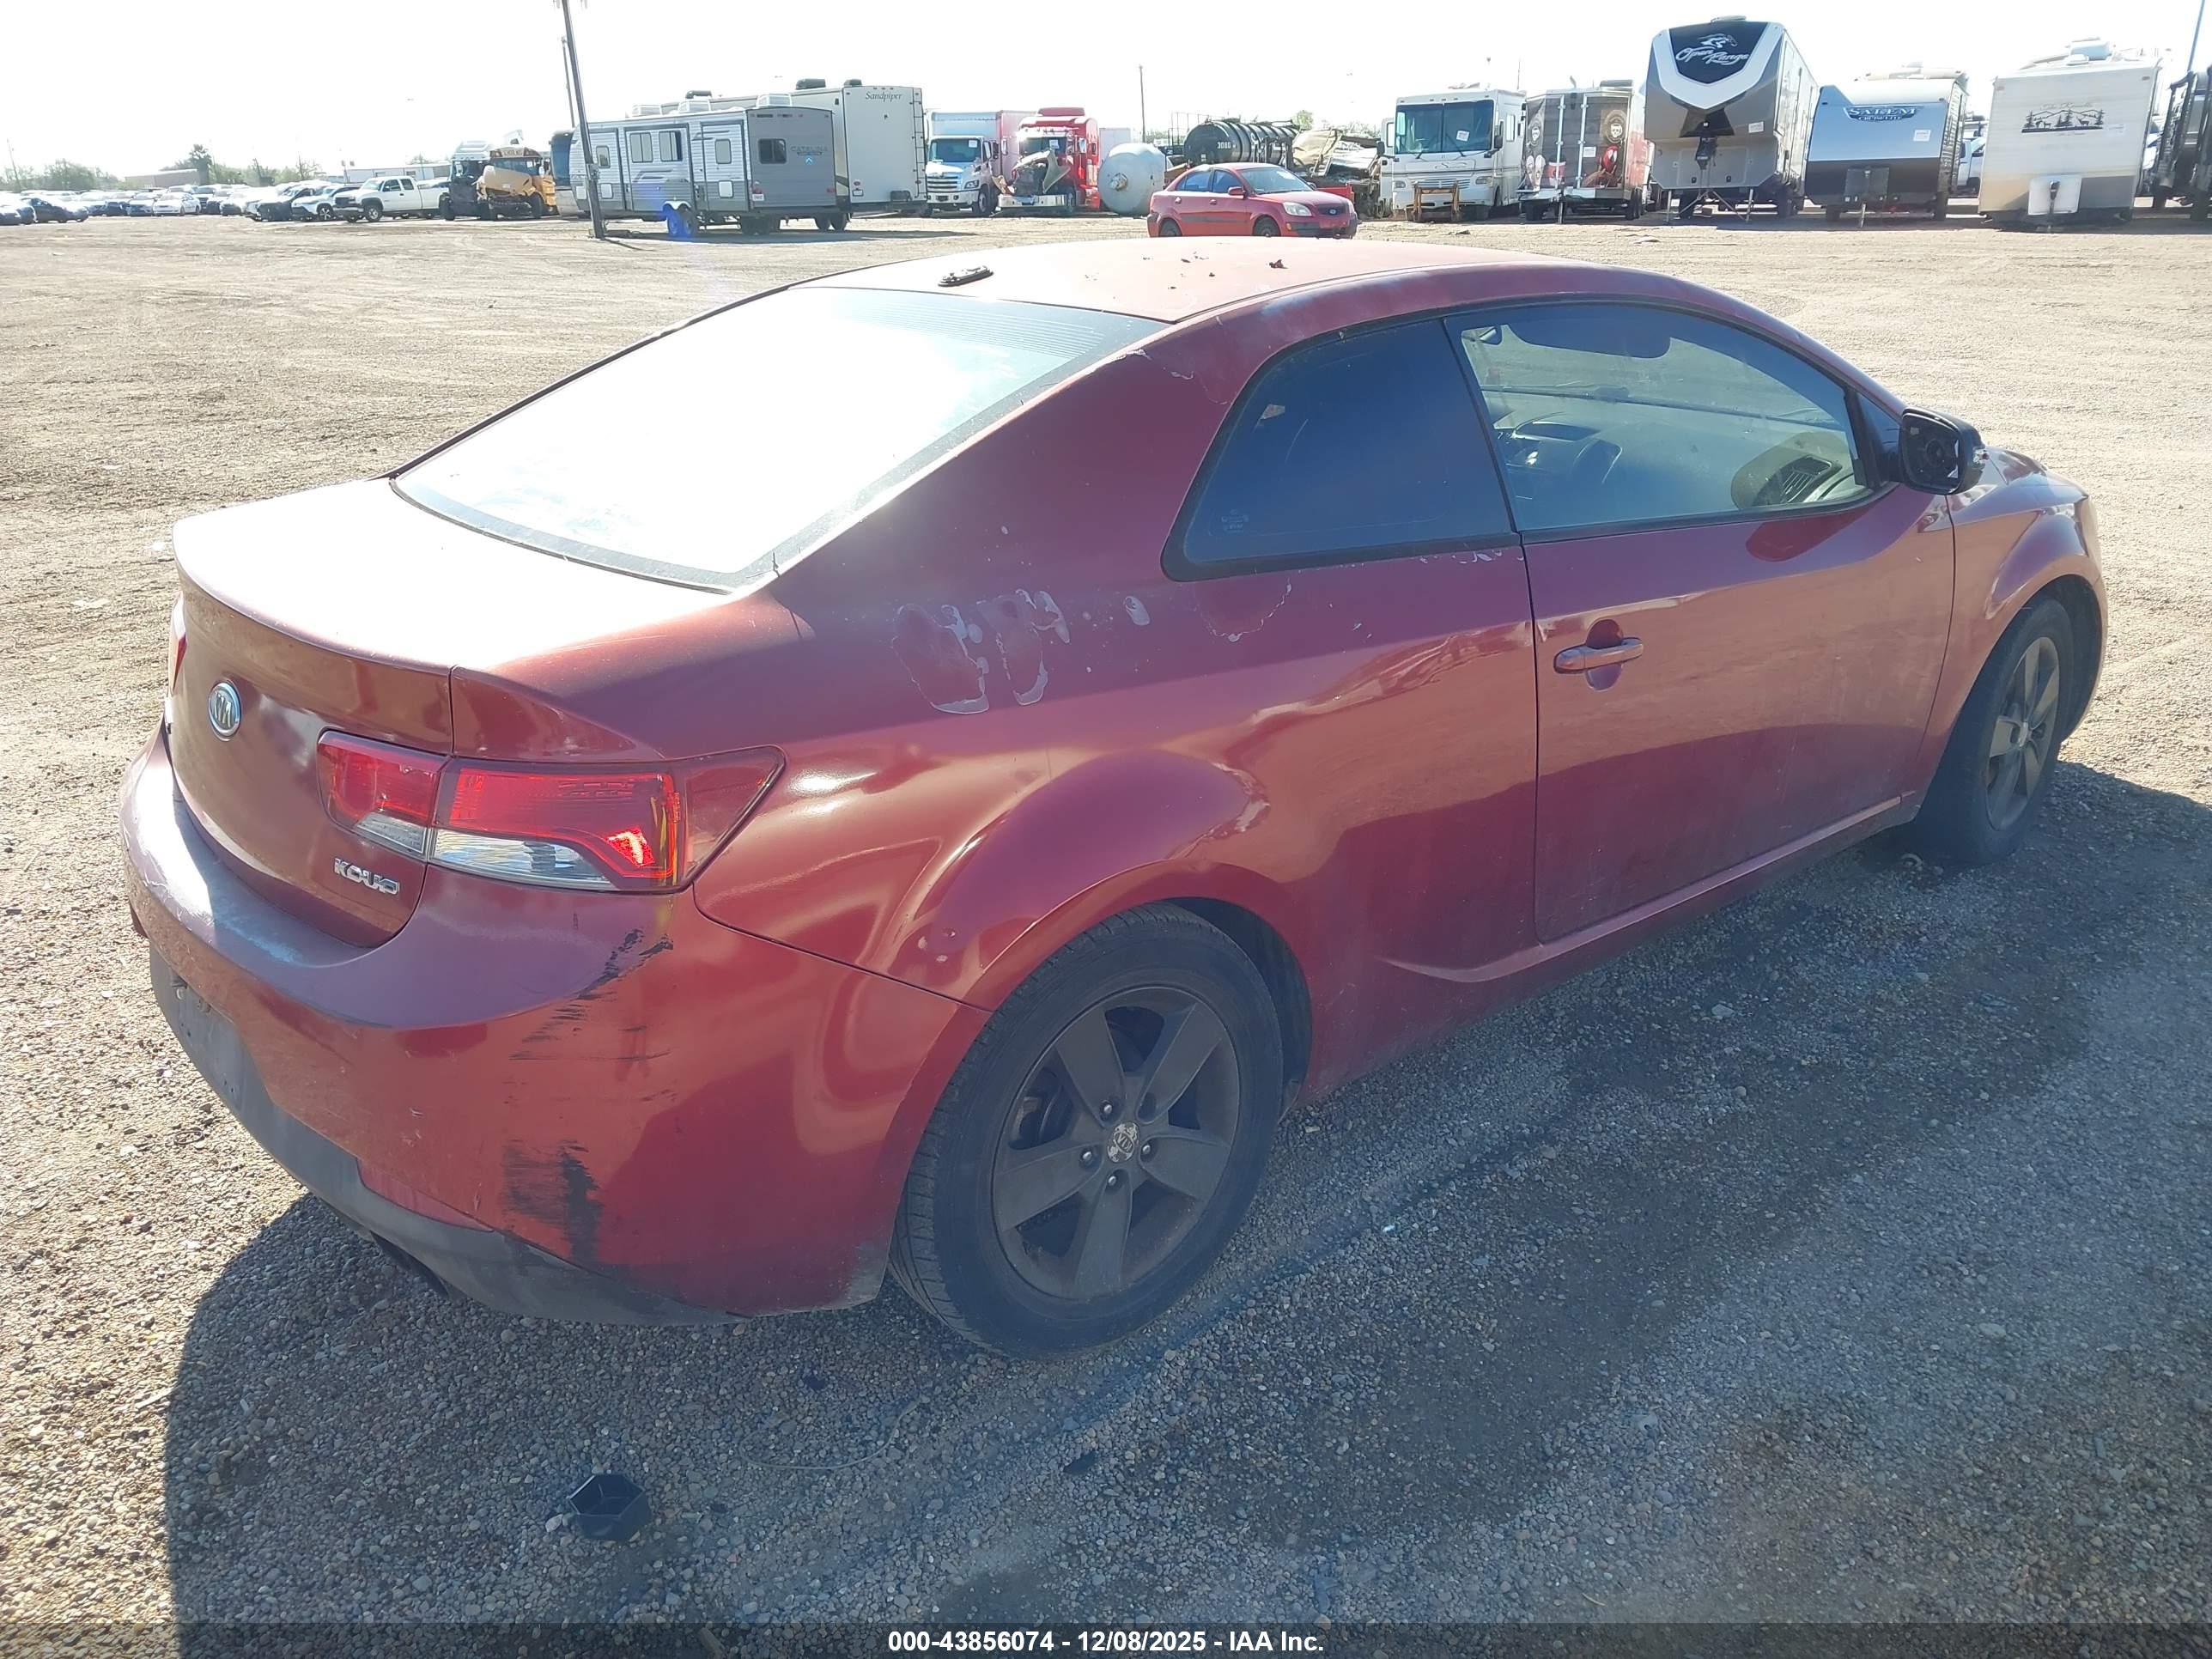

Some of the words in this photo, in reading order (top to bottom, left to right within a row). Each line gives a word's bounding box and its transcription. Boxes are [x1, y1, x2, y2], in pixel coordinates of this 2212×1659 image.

[1676, 46, 1717, 62] Open
[1702, 52, 1749, 65] Range
[866, 91, 902, 102] Sandpiper
[334, 857, 400, 895] KOUP
